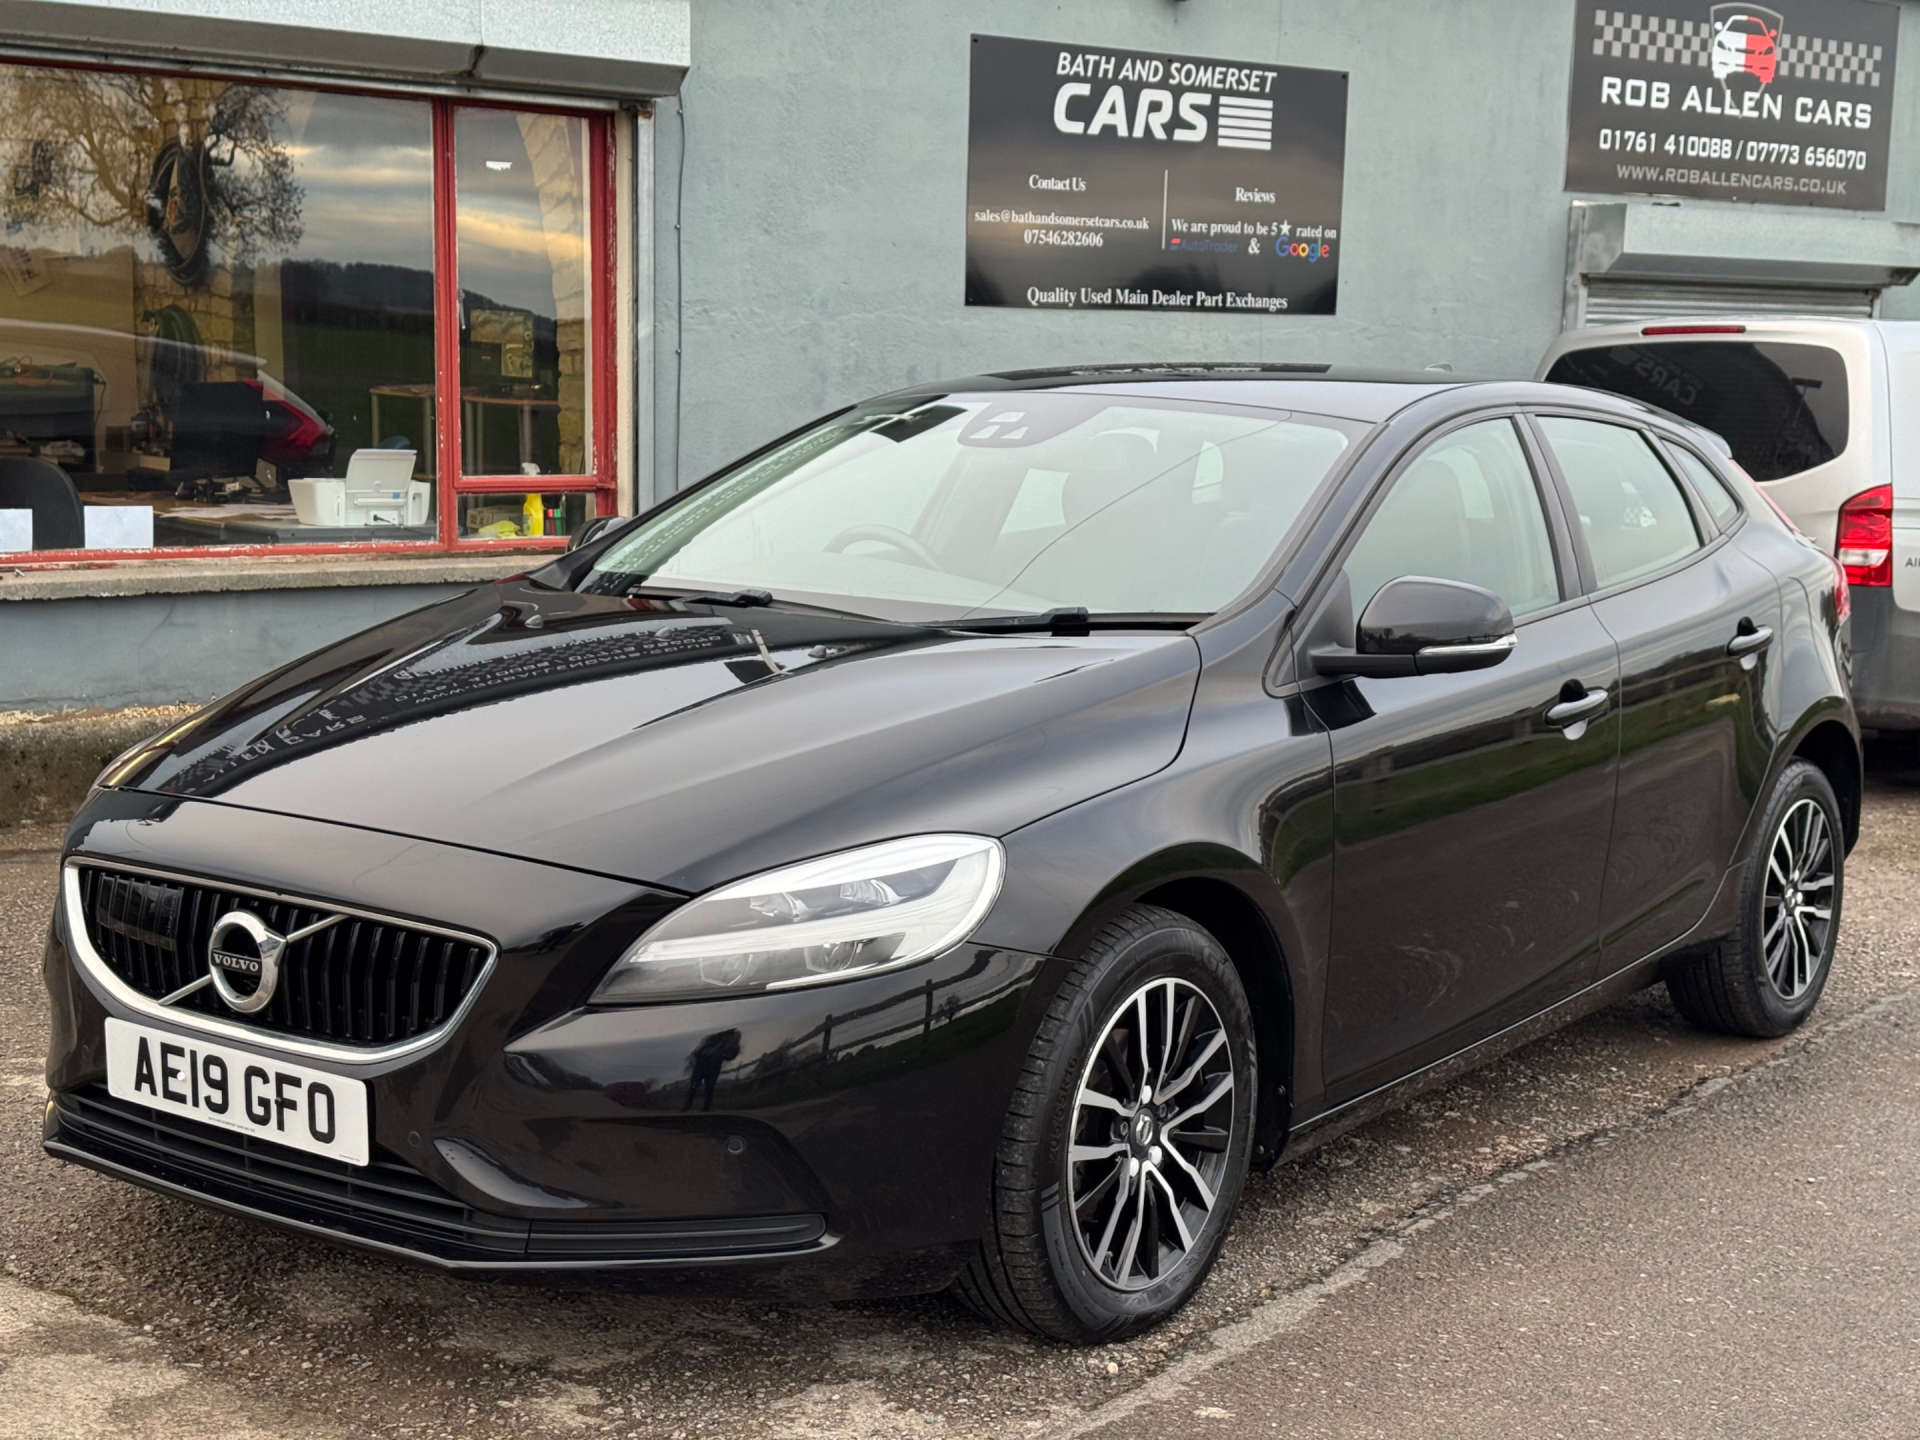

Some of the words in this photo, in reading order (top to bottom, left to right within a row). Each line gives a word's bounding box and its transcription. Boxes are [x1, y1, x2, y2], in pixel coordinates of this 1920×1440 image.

[1056, 51, 1115, 80] BATH
[1118, 58, 1164, 83] AND
[1168, 62, 1278, 93] SOMERSET
[1053, 82, 1213, 142] CARS
[1600, 76, 1670, 110] ROB
[1681, 85, 1783, 121] ALLEN
[1794, 97, 1873, 130] CARS
[1599, 128, 1656, 153] 01761
[1664, 133, 1732, 161] 410088
[1735, 139, 1744, 161] /
[1746, 140, 1800, 165] 07773
[1804, 146, 1867, 171] 656070
[1029, 174, 1070, 191] Contact
[1071, 177, 1087, 192] Us
[1616, 164, 1848, 196] WWW.ROBALLENCARS.CO.UK
[1235, 187, 1276, 203] Reviews
[975, 209, 1150, 230] sales@bathandsomersetcars.co.uk
[1171, 218, 1189, 233] We
[1190, 222, 1209, 233] are
[1210, 221, 1242, 237] proud
[1243, 223, 1254, 235] to
[1256, 222, 1269, 236] be
[1296, 225, 1322, 239] rated
[1324, 228, 1337, 239] on
[1023, 228, 1104, 248] 07546282606
[1248, 237, 1261, 255] &
[1275, 236, 1331, 263] Google
[1027, 286, 1077, 307] Quality
[1081, 287, 1112, 304] Used
[1115, 289, 1149, 305] Main
[1151, 290, 1193, 306] Dealer
[1196, 291, 1223, 308] Part
[1226, 292, 1288, 312] Exchanges
[213, 953, 259, 972] VOLVO
[134, 1036, 230, 1115] AE19
[244, 1065, 337, 1145] GFO
